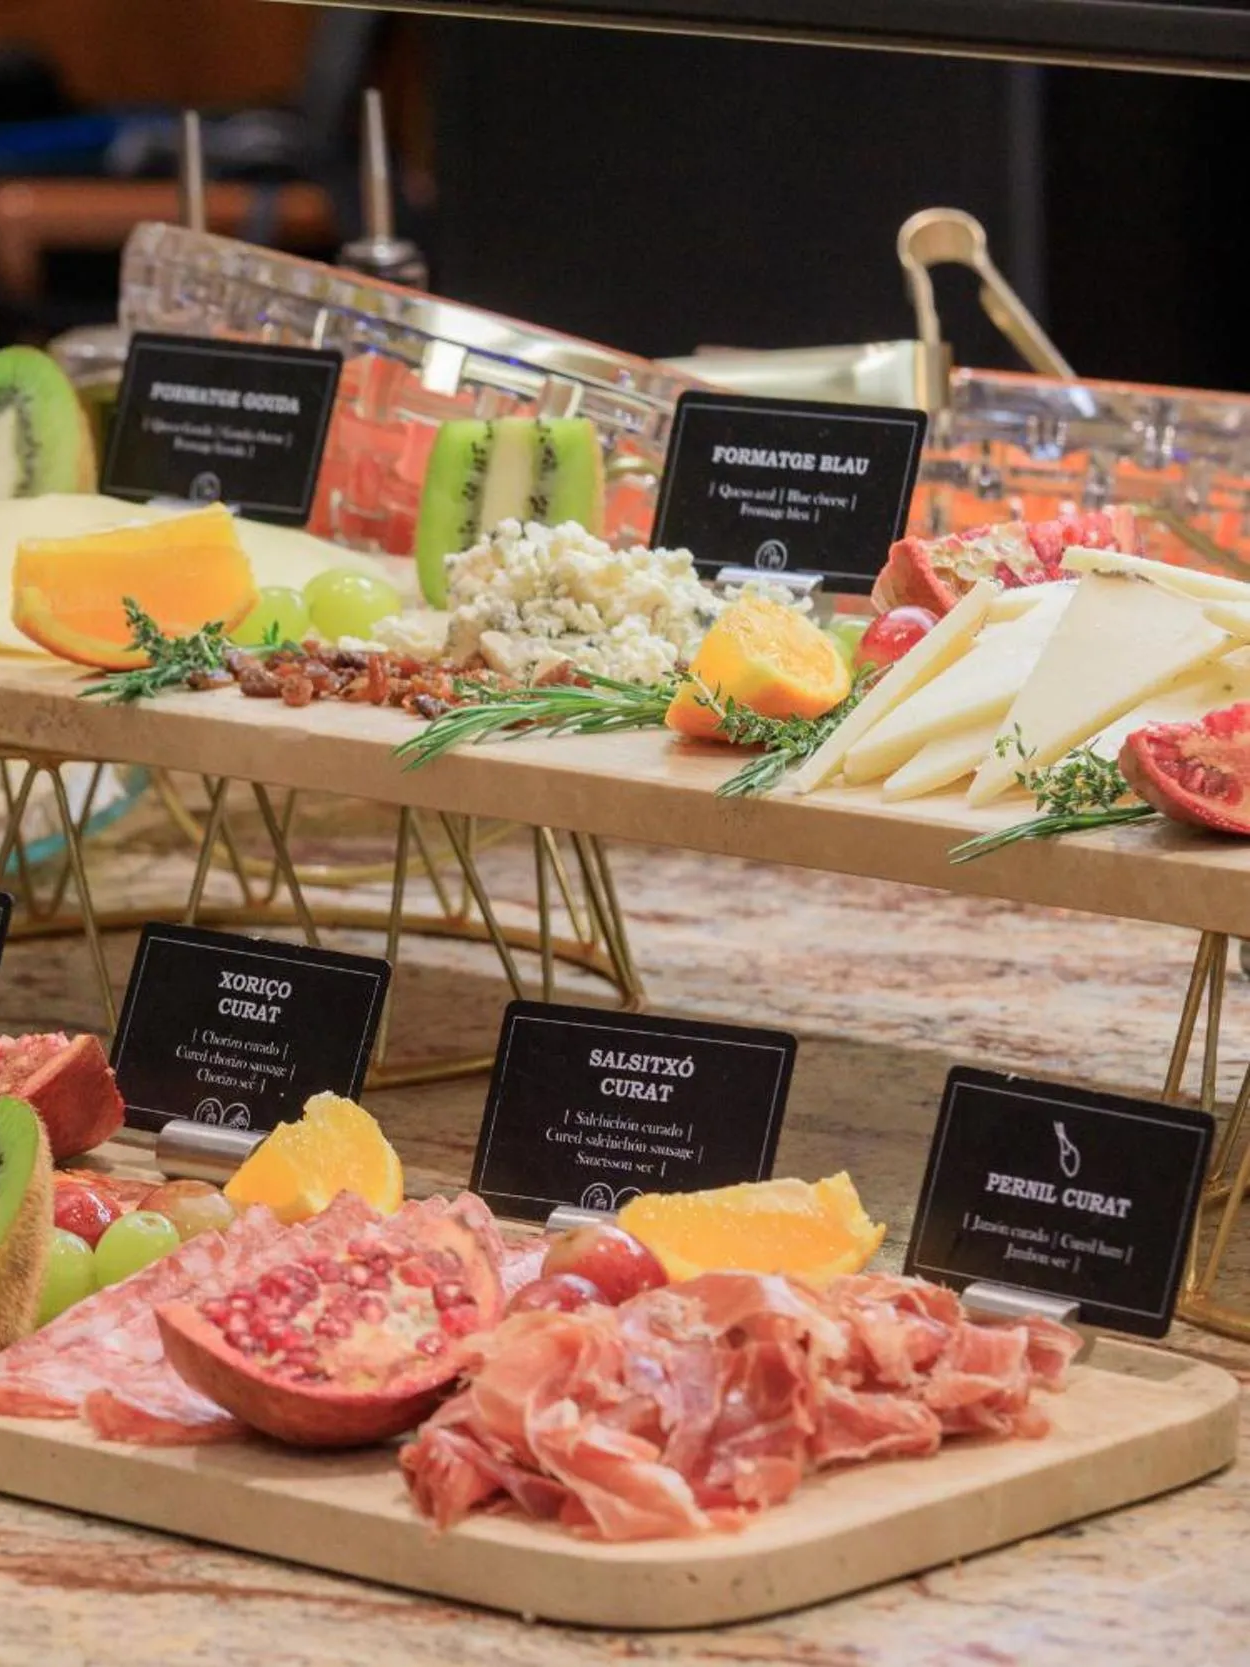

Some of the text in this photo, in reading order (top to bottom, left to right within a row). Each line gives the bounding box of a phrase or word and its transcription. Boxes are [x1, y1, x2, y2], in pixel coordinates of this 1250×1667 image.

[712, 446, 869, 475] FORMATGE BLAU
[218, 971, 292, 1000] XORIÇO
[218, 998, 281, 1023] CURAT
[202, 1029, 279, 1056] Chorizo curado
[176, 1044, 287, 1077] Cured chorizo sausage
[589, 1048, 695, 1078] SALSITXÓ
[196, 1067, 237, 1086] Chorizo
[600, 1077, 674, 1103] CURAT
[575, 1110, 684, 1137] Salchichón curado
[546, 1127, 695, 1160] Cured salchichón sausage
[576, 1151, 655, 1173] Saucisson sec
[984, 1172, 1132, 1218] PERNIL CURAT
